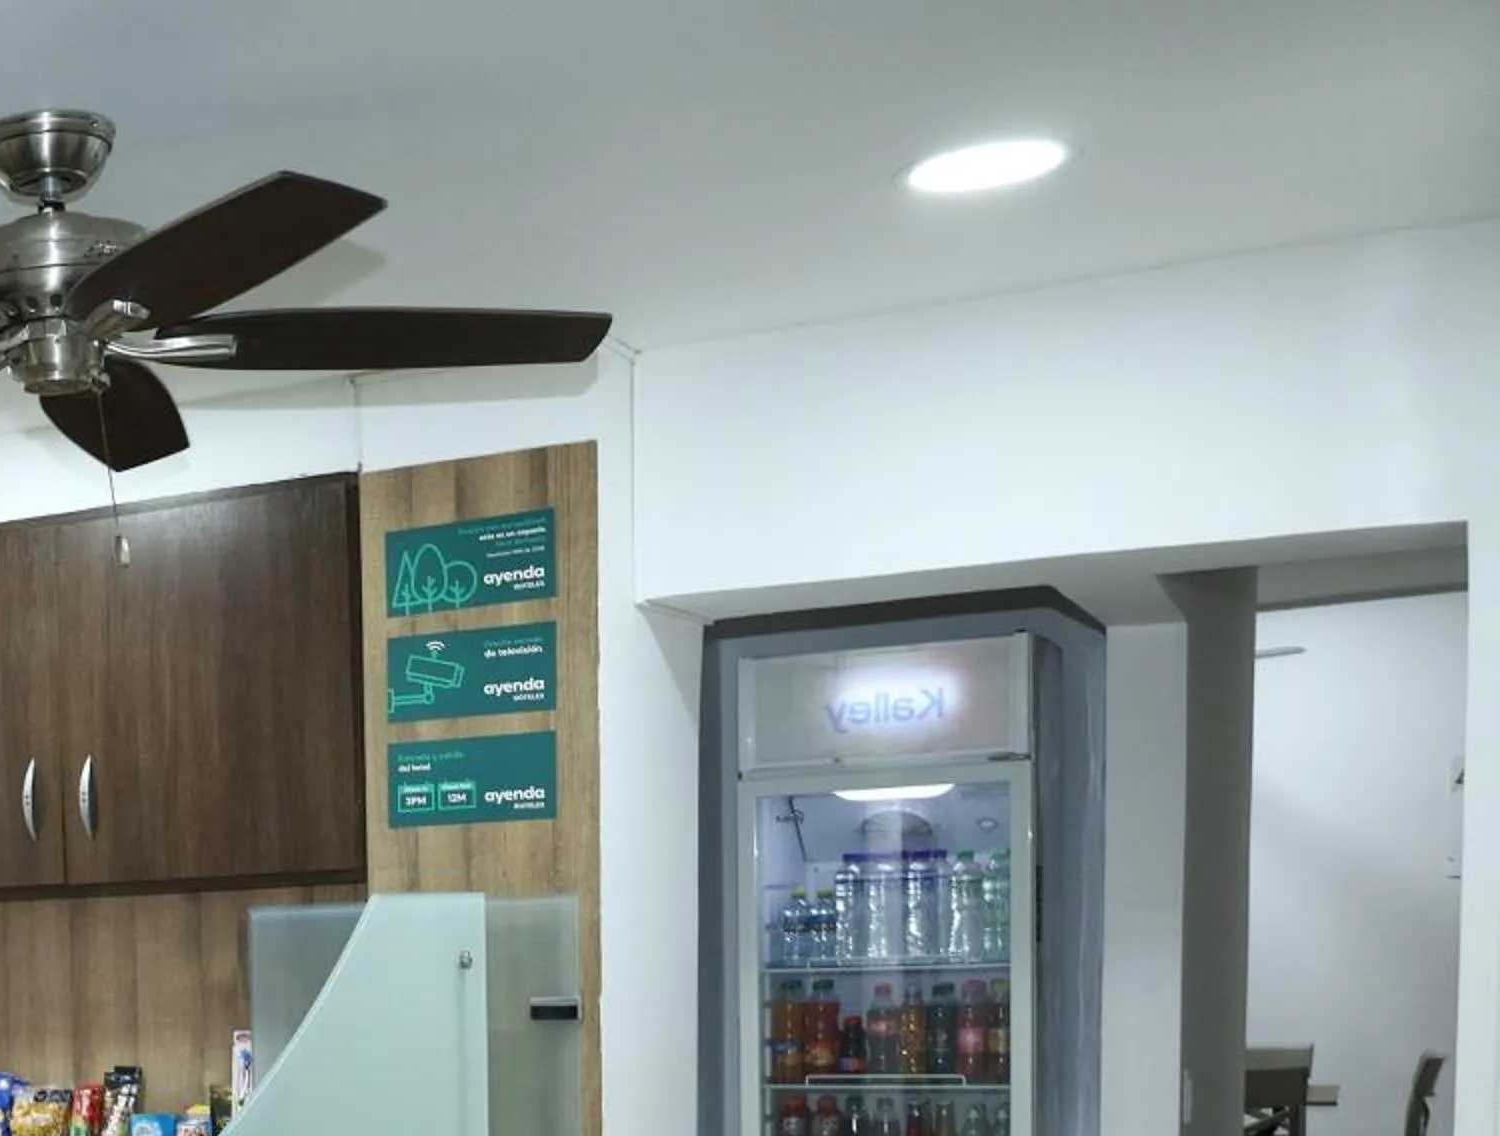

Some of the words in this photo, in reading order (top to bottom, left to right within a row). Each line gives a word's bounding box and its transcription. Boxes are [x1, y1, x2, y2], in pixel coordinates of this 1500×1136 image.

[483, 565, 545, 586] ayenda
[483, 677, 545, 697] ayenda
[484, 786, 546, 805] ayenda
